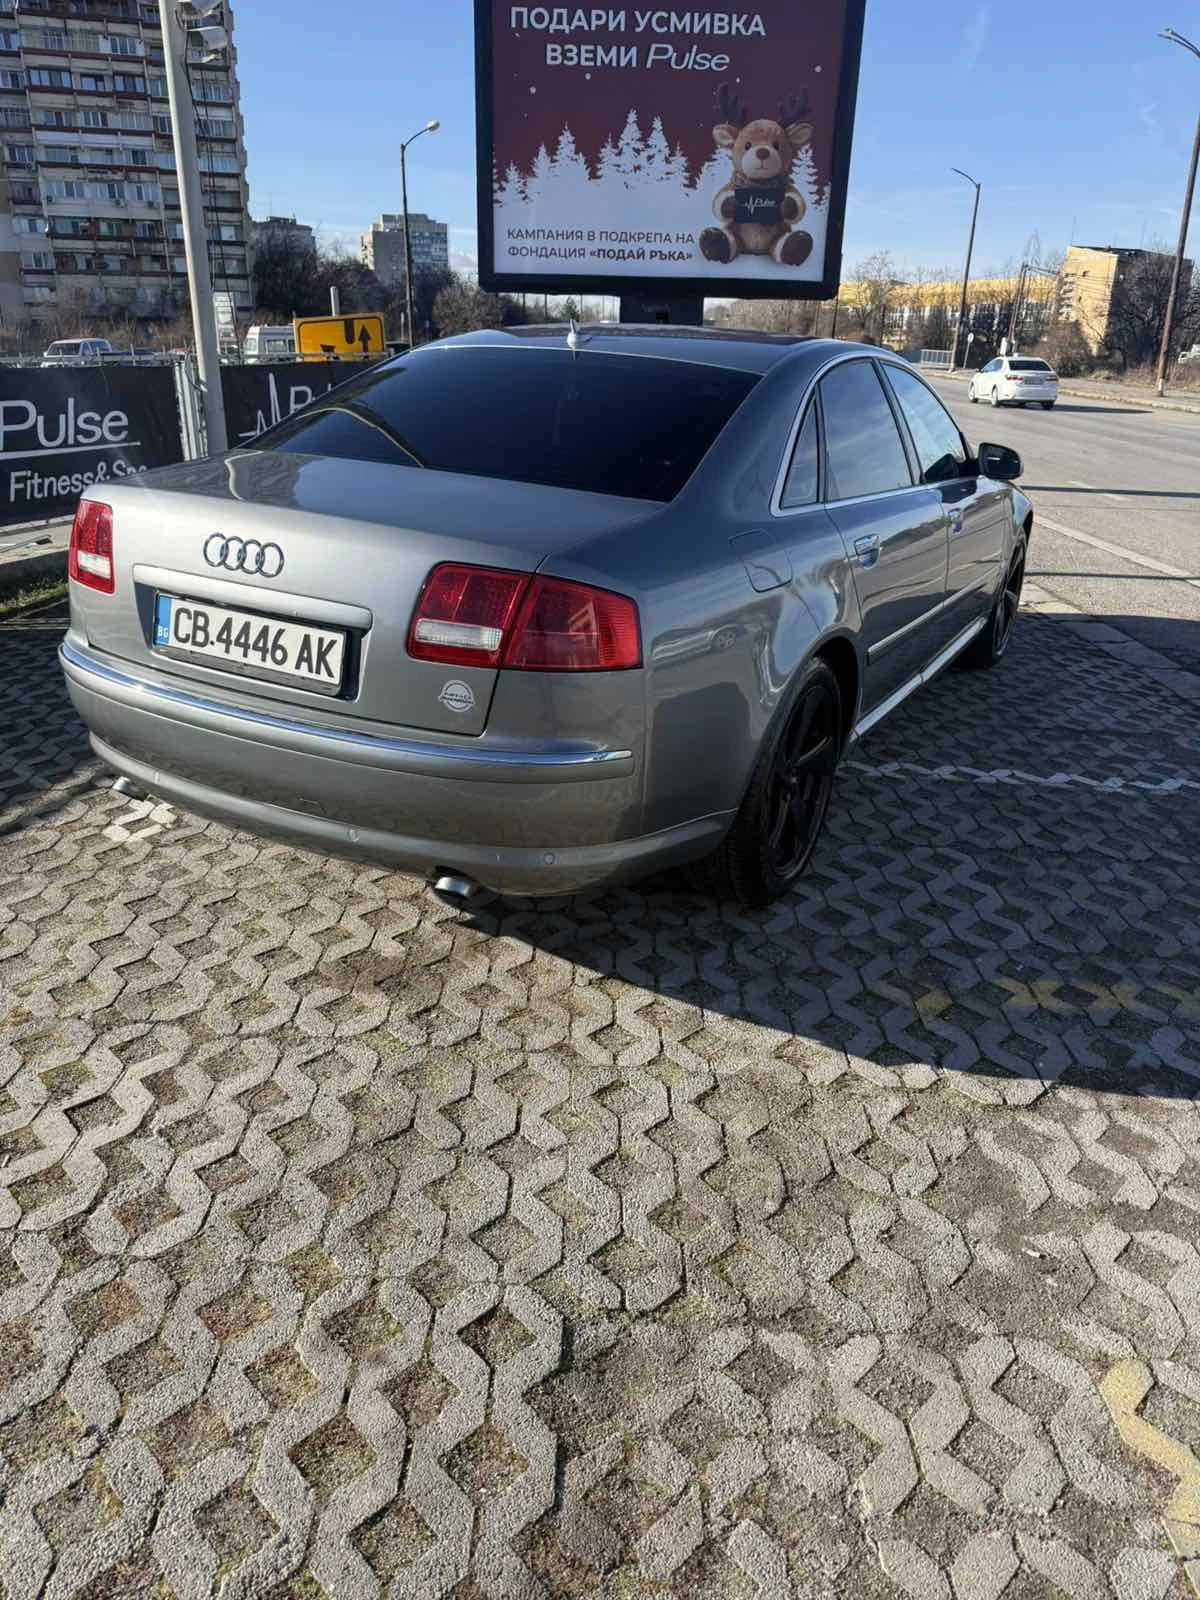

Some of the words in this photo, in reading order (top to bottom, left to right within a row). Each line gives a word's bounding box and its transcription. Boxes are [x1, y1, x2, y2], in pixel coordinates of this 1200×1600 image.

[510, 7, 627, 34] ПОДАРИ
[634, 11, 767, 36] УСМИВКА
[545, 43, 637, 67] ВЗЕМИ
[646, 43, 730, 71] Pulse
[507, 228, 583, 241] КАМПАНИЯ
[587, 231, 596, 241] В
[600, 231, 673, 245] ПОДКРЕПА
[675, 233, 695, 244] НА
[507, 246, 586, 258] ФОНДАЦИЯ
[589, 248, 646, 261] «ПОДАЙ
[649, 249, 693, 261] РЪКА»
[0, 397, 129, 450] Pulse
[157, 625, 169, 638] BG
[295, 634, 337, 679] AK
